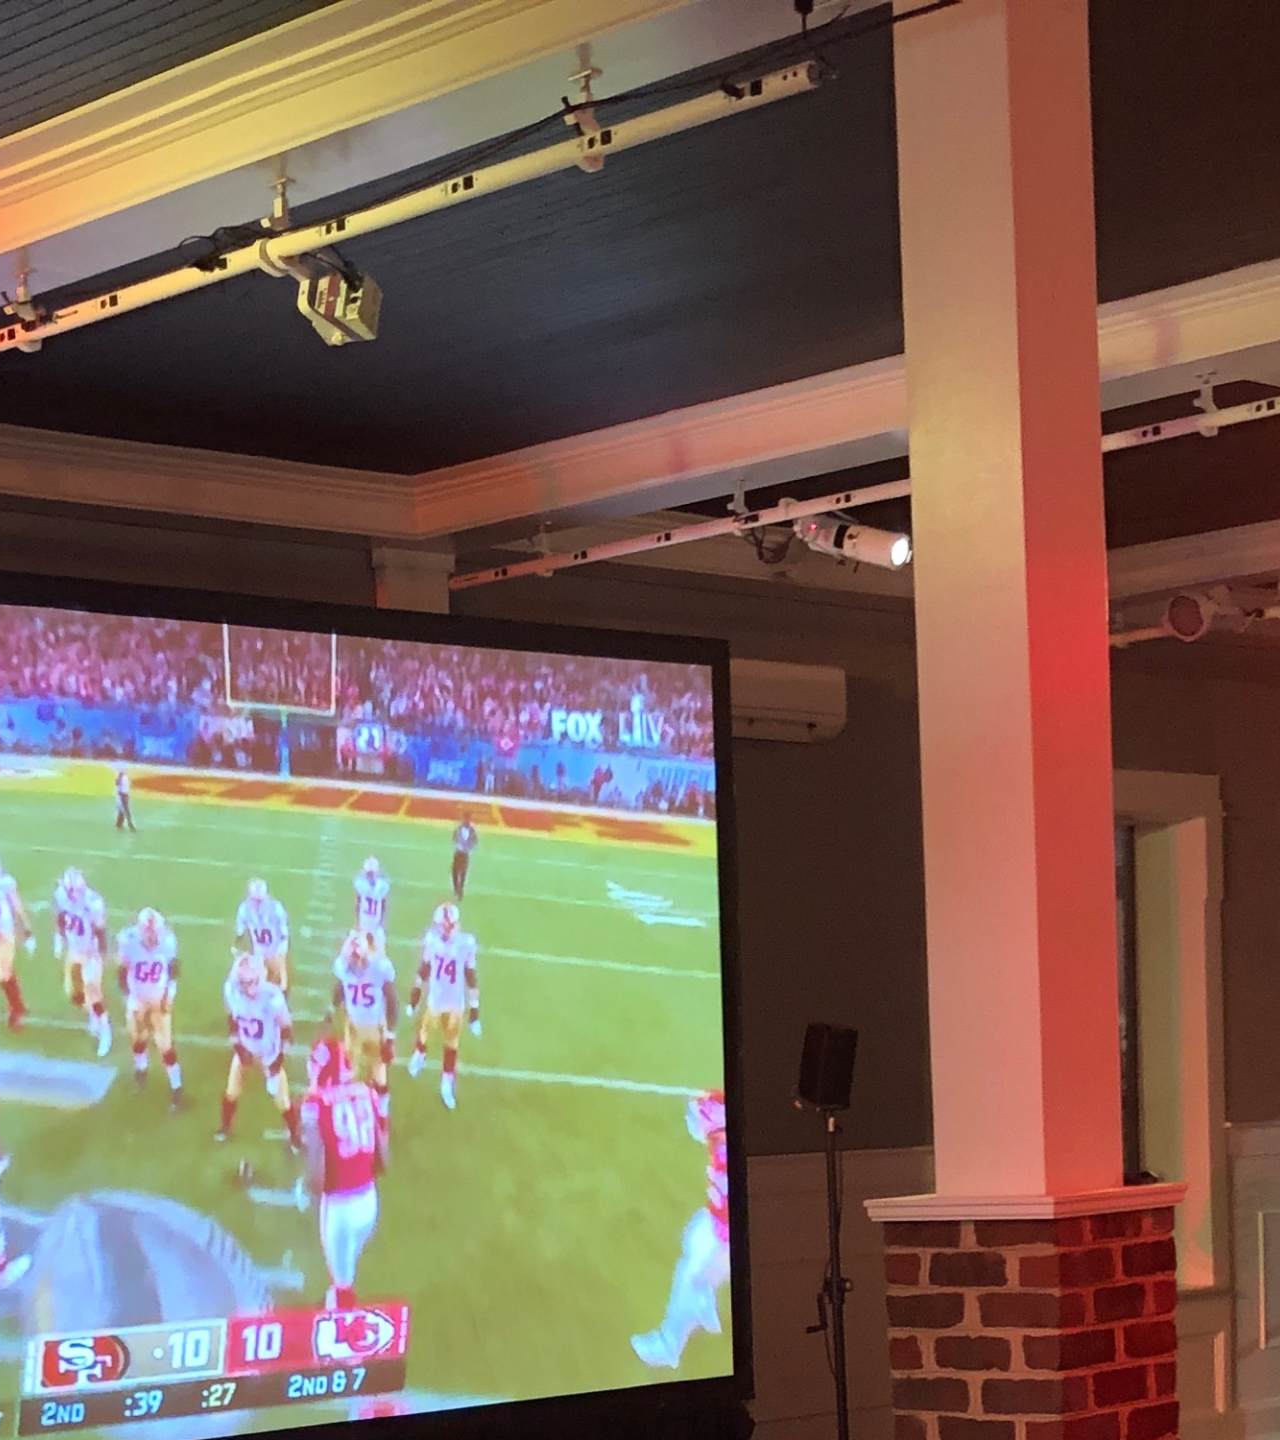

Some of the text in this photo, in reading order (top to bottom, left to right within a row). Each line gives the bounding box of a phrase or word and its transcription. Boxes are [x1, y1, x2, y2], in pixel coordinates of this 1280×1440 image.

[551, 707, 604, 746] FOX
[347, 983, 376, 1008] 75
[168, 1329, 211, 1369] 10
[241, 1322, 283, 1362] 10
[40, 1401, 86, 1426] 2ND
[124, 1389, 164, 1417] :39
[200, 1382, 237, 1409] :27
[287, 1373, 328, 1399] 2ND
[352, 1367, 367, 1391] 7
